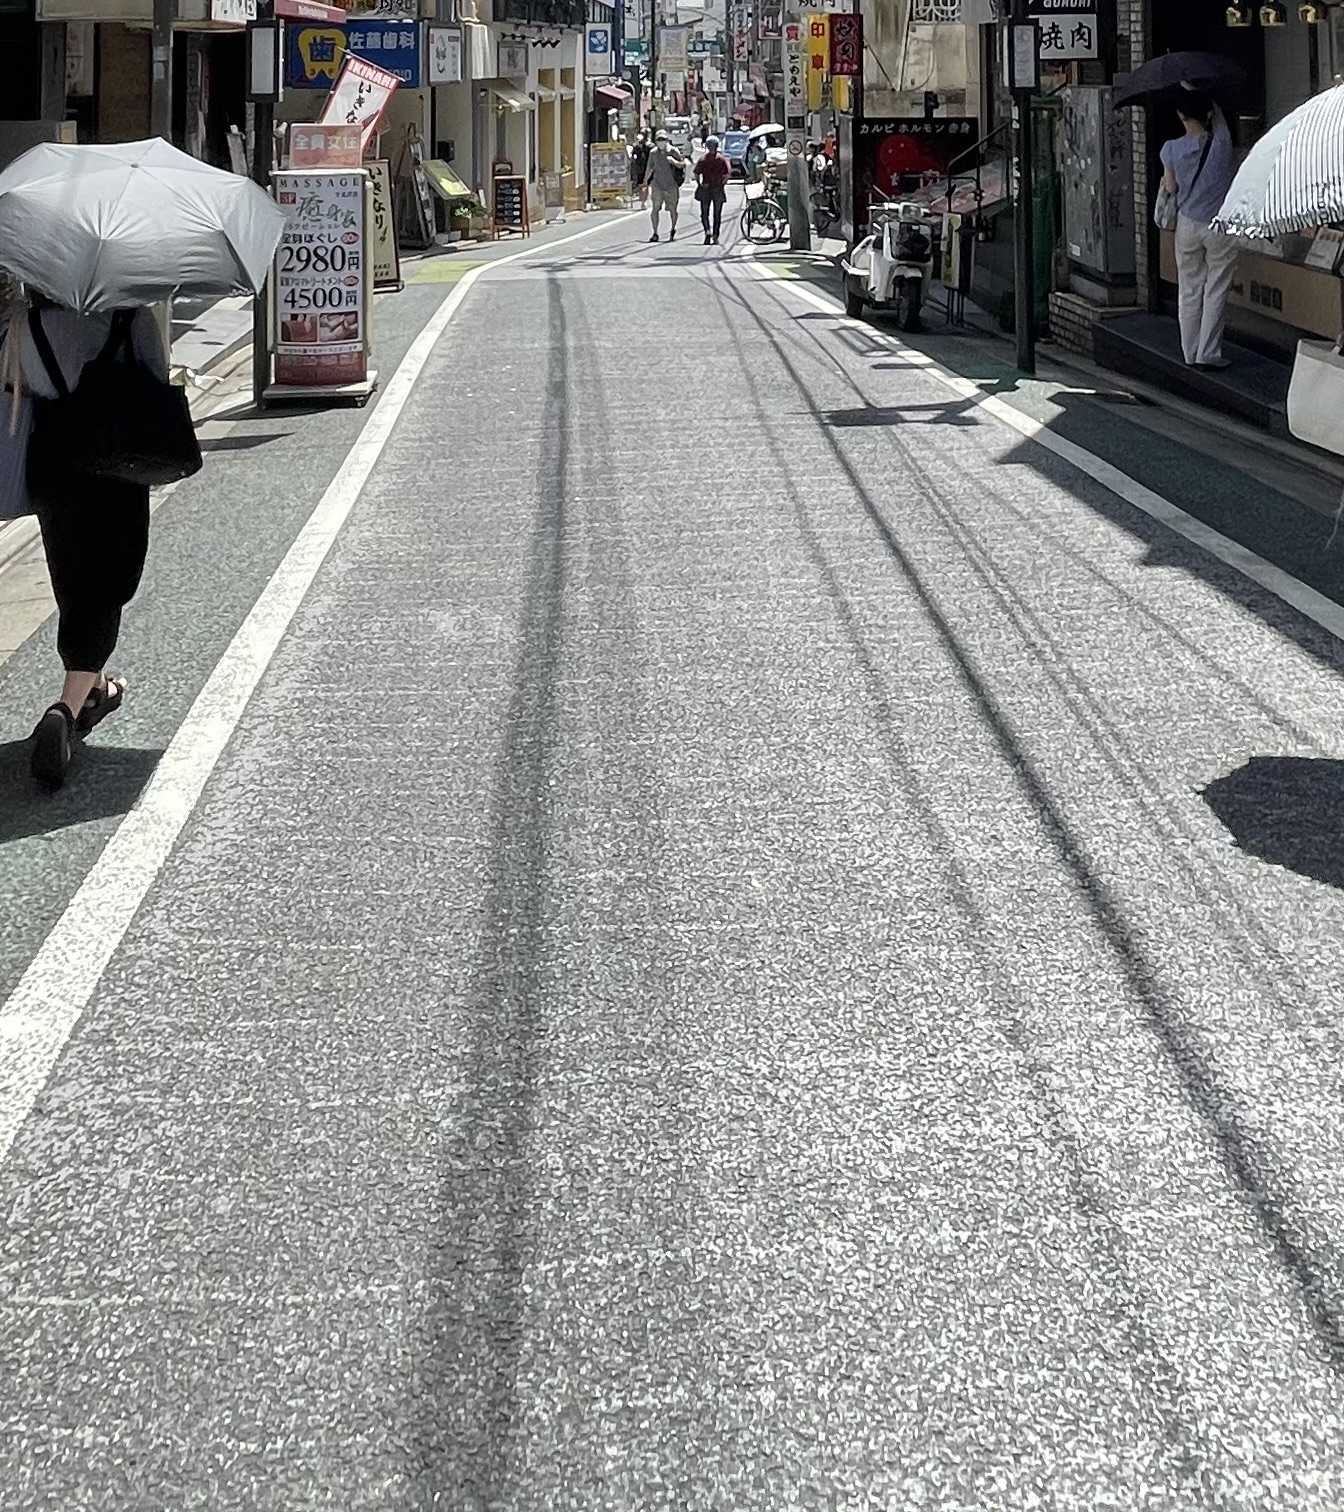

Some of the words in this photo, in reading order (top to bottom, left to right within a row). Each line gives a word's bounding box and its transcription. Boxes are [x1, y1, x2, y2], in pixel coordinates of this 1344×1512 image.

[1039, 21, 1093, 50] 焼肉
[347, 59, 398, 89] IKINARI
[279, 178, 359, 188] MASSAGE
